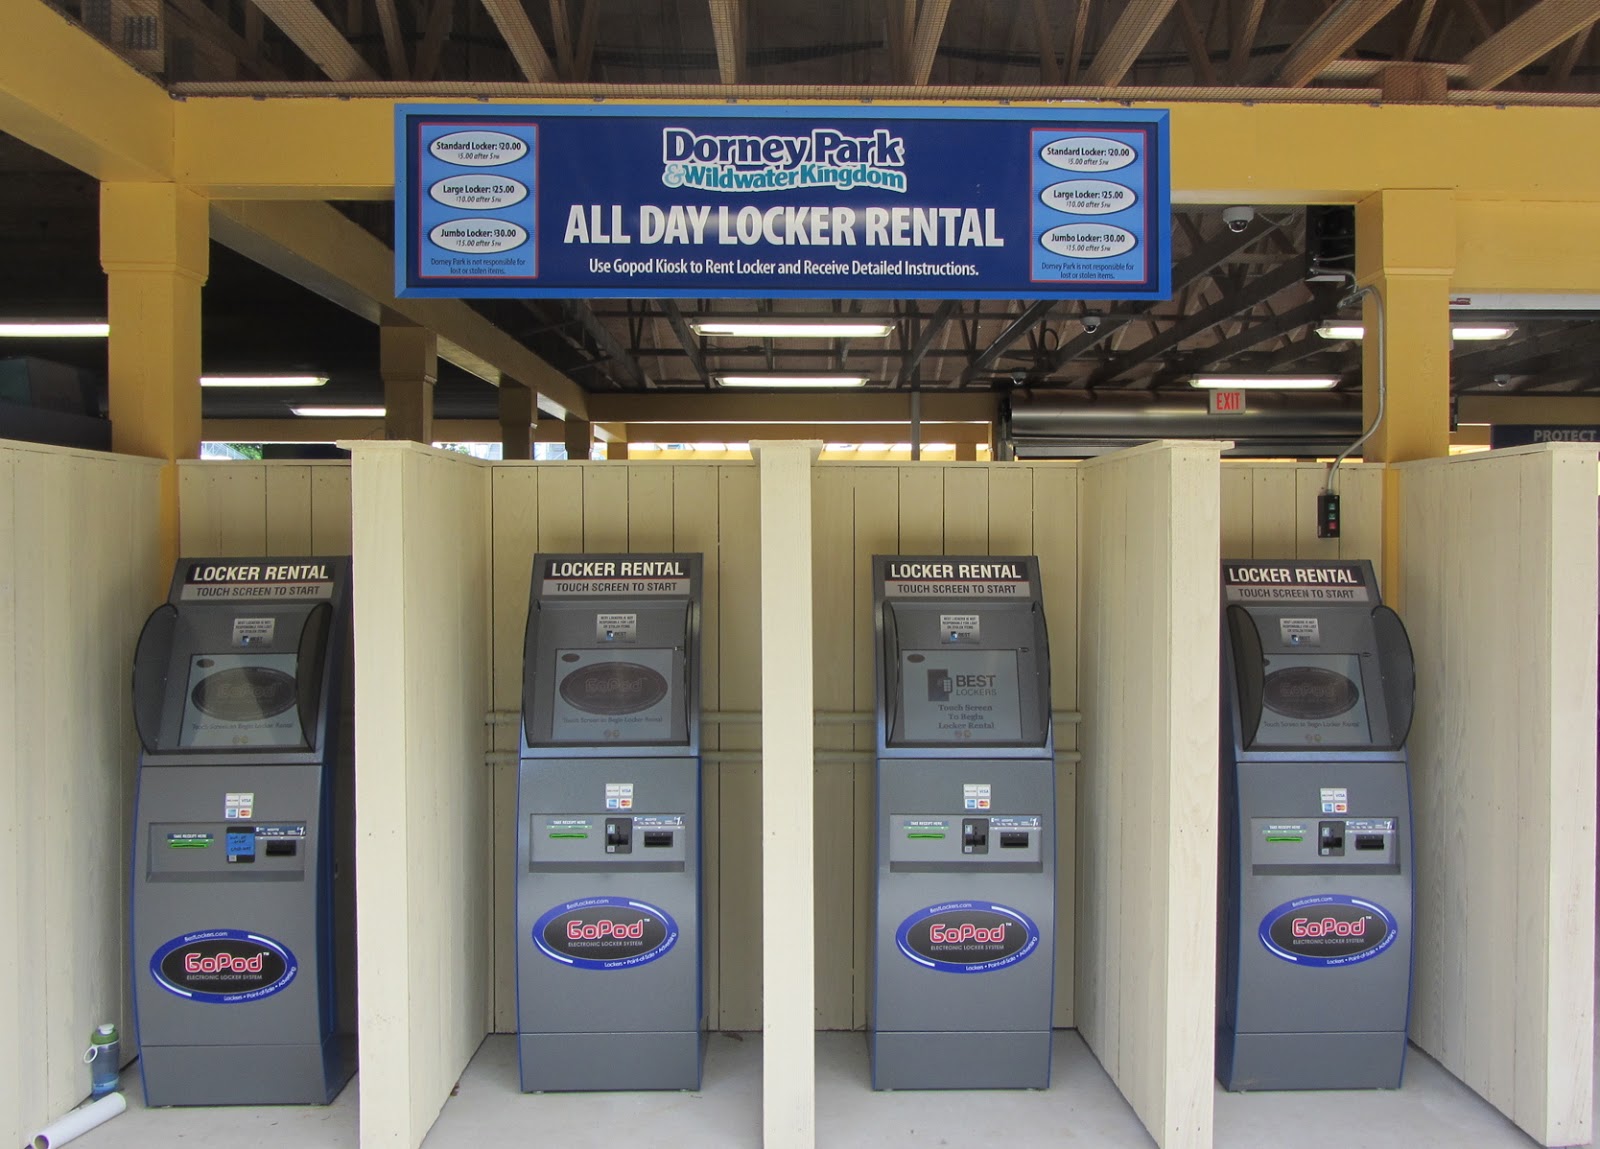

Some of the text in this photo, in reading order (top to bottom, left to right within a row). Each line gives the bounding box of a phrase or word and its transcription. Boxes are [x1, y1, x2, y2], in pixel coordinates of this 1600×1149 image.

[437, 142, 470, 150] Standard
[663, 127, 905, 169] Dorney Park
[443, 186, 463, 195] Large
[1054, 190, 1073, 200] Large
[564, 205, 1004, 246] ALL DAY LOCKER RENTAL
[441, 229, 465, 237] Jumbo
[590, 258, 979, 276] Use Gopod Kiosk to Rent Locker and Receive Detailed Instructions.
[1042, 263, 1062, 271] Dorney
[1216, 392, 1240, 410] EXIT
[1534, 430, 1596, 442] PROTECT
[194, 566, 328, 581] LOCKER RENTAL
[552, 562, 683, 576] LOCKER RENTAL
[891, 564, 1021, 578] LOCKER RENTAL
[1229, 568, 1357, 583] LOCKER RENTAL
[197, 586, 320, 596] TOUCH SCREEN TO START
[557, 582, 677, 592] TOUCH SCREEN TO START
[898, 584, 1016, 594] TOUCH SCREEN TO START
[1239, 588, 1354, 598] TOUCH SCREEN TO START
[956, 675, 996, 687] BEST
